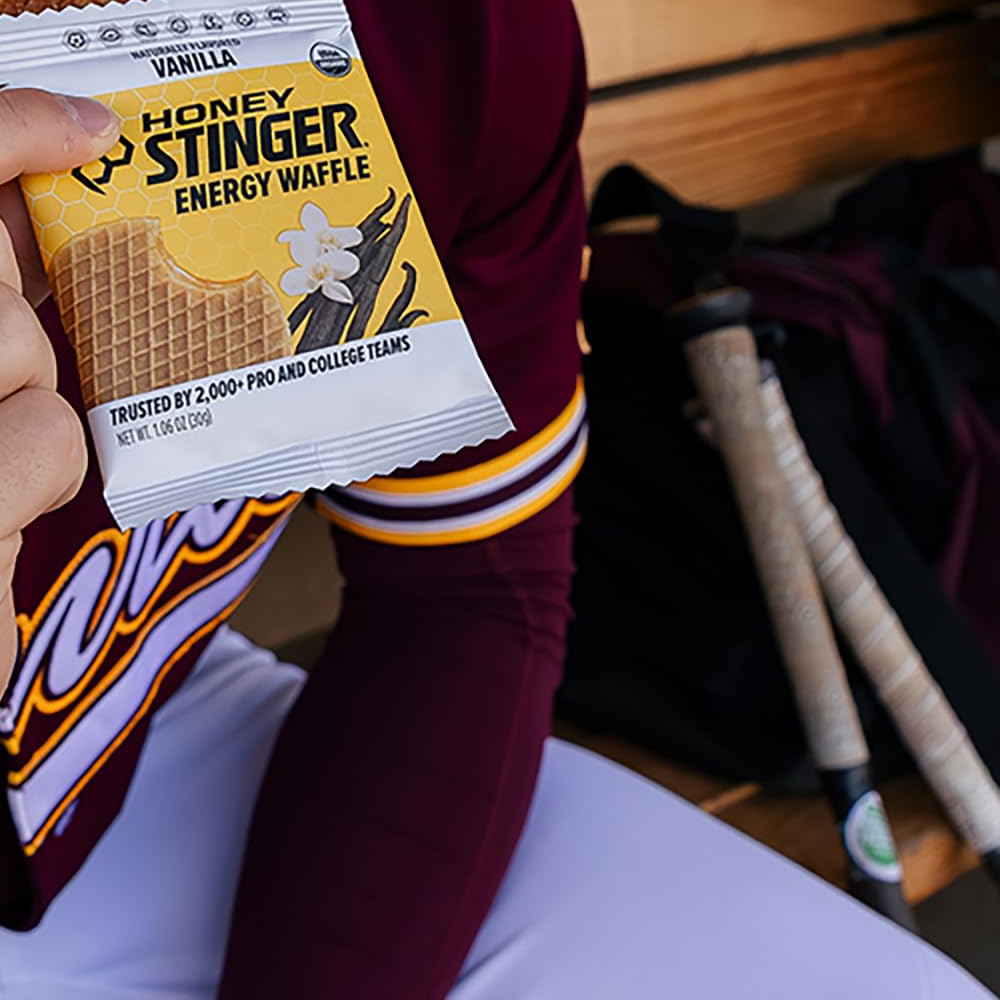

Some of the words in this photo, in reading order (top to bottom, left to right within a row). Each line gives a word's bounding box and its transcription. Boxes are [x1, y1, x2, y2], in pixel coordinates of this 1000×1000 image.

[150, 48, 238, 78] VANILLA
[142, 87, 294, 132] HONEY
[175, 170, 272, 215] ENERGY
[277, 155, 371, 193] WAFFLE
[110, 395, 171, 426] TRUSTED
[174, 388, 192, 410] BY
[195, 378, 243, 404] 2,000+
[247, 368, 275, 391] PRO
[278, 361, 306, 383] AND
[308, 345, 365, 375] COLLEGE
[366, 334, 411, 361] TEAMS
[116, 429, 136, 447] NET
